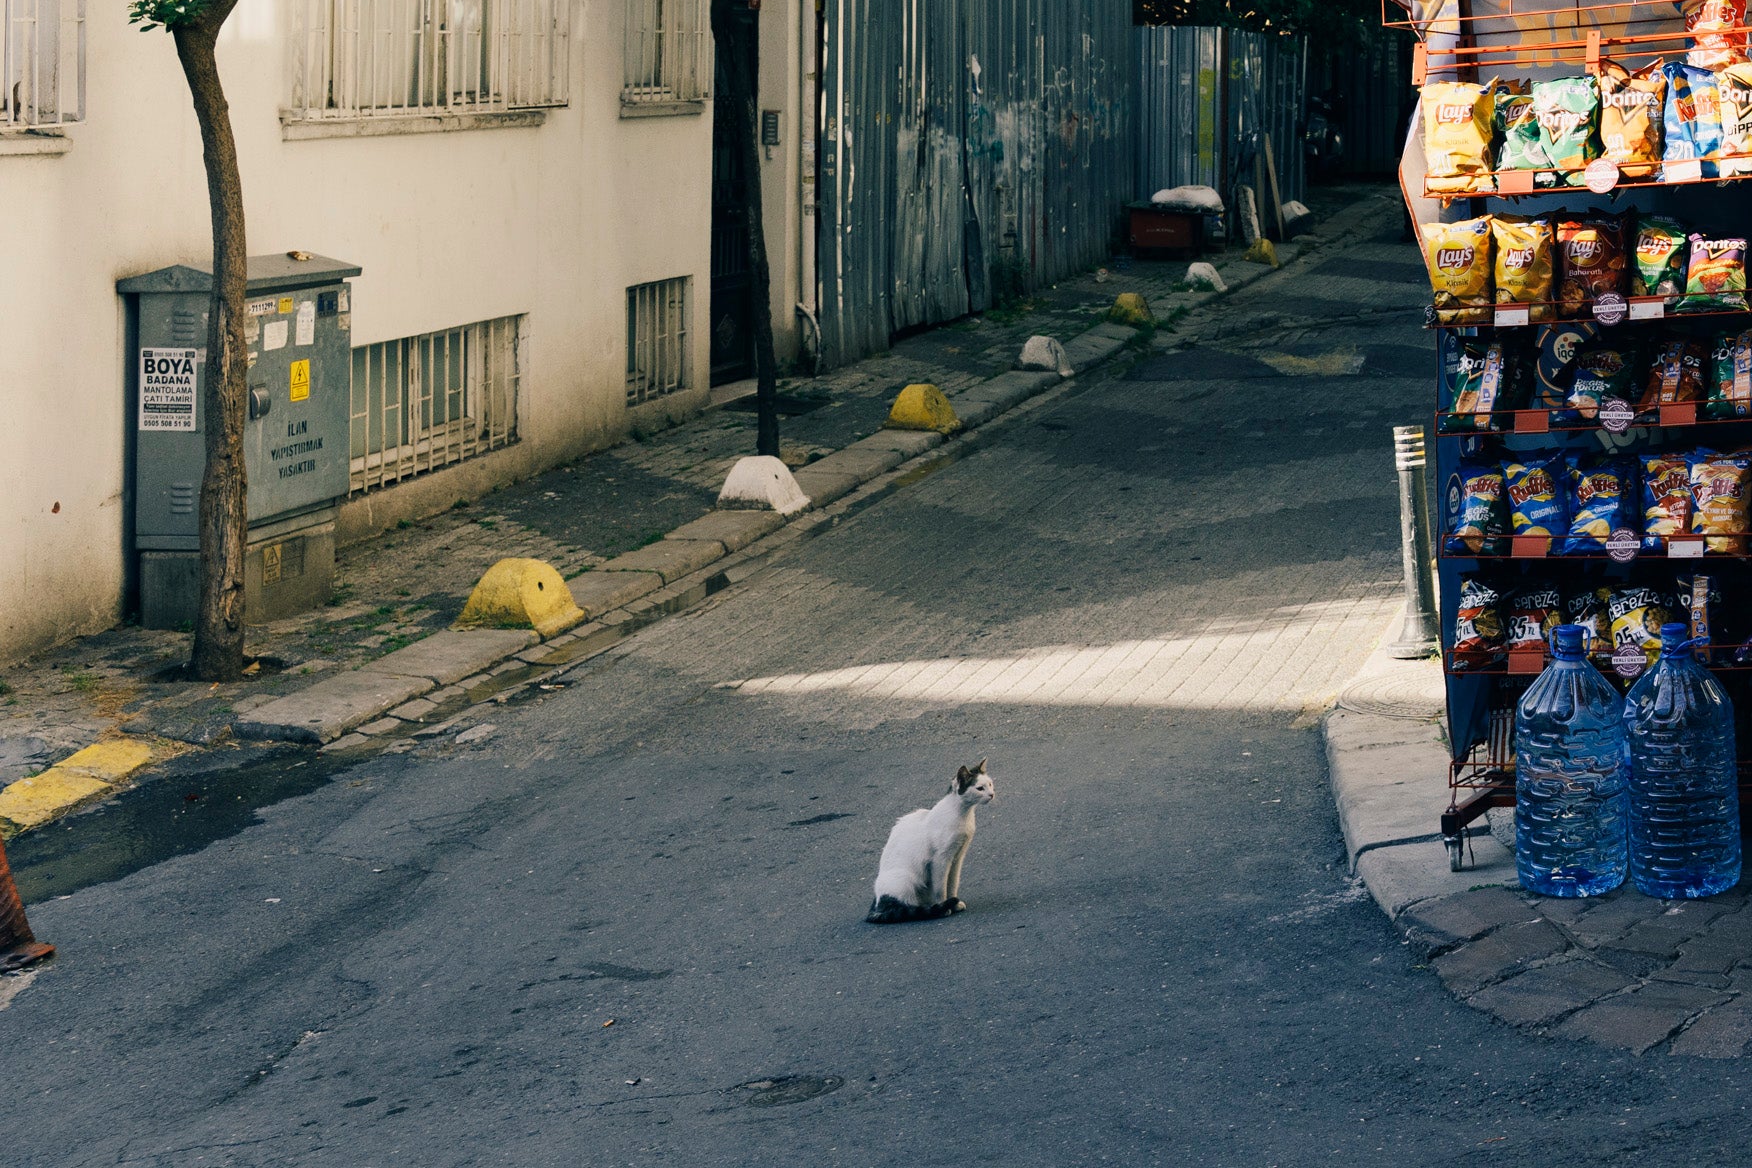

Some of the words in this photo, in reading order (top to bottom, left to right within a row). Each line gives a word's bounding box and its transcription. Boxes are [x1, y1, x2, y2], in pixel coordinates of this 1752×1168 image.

[1692, 238, 1747, 254] Doritos
[1439, 245, 1473, 268] Lay's
[1446, 278, 1469, 287] Klasik
[144, 358, 195, 375] BOYA
[146, 375, 191, 385] BADANA
[144, 386, 193, 394] MANTOLAMA
[144, 395, 163, 404] ÇATI
[165, 394, 193, 402] TAMİRİ
[1508, 476, 1556, 507] Ruffles
[1576, 478, 1621, 506] Ruffles
